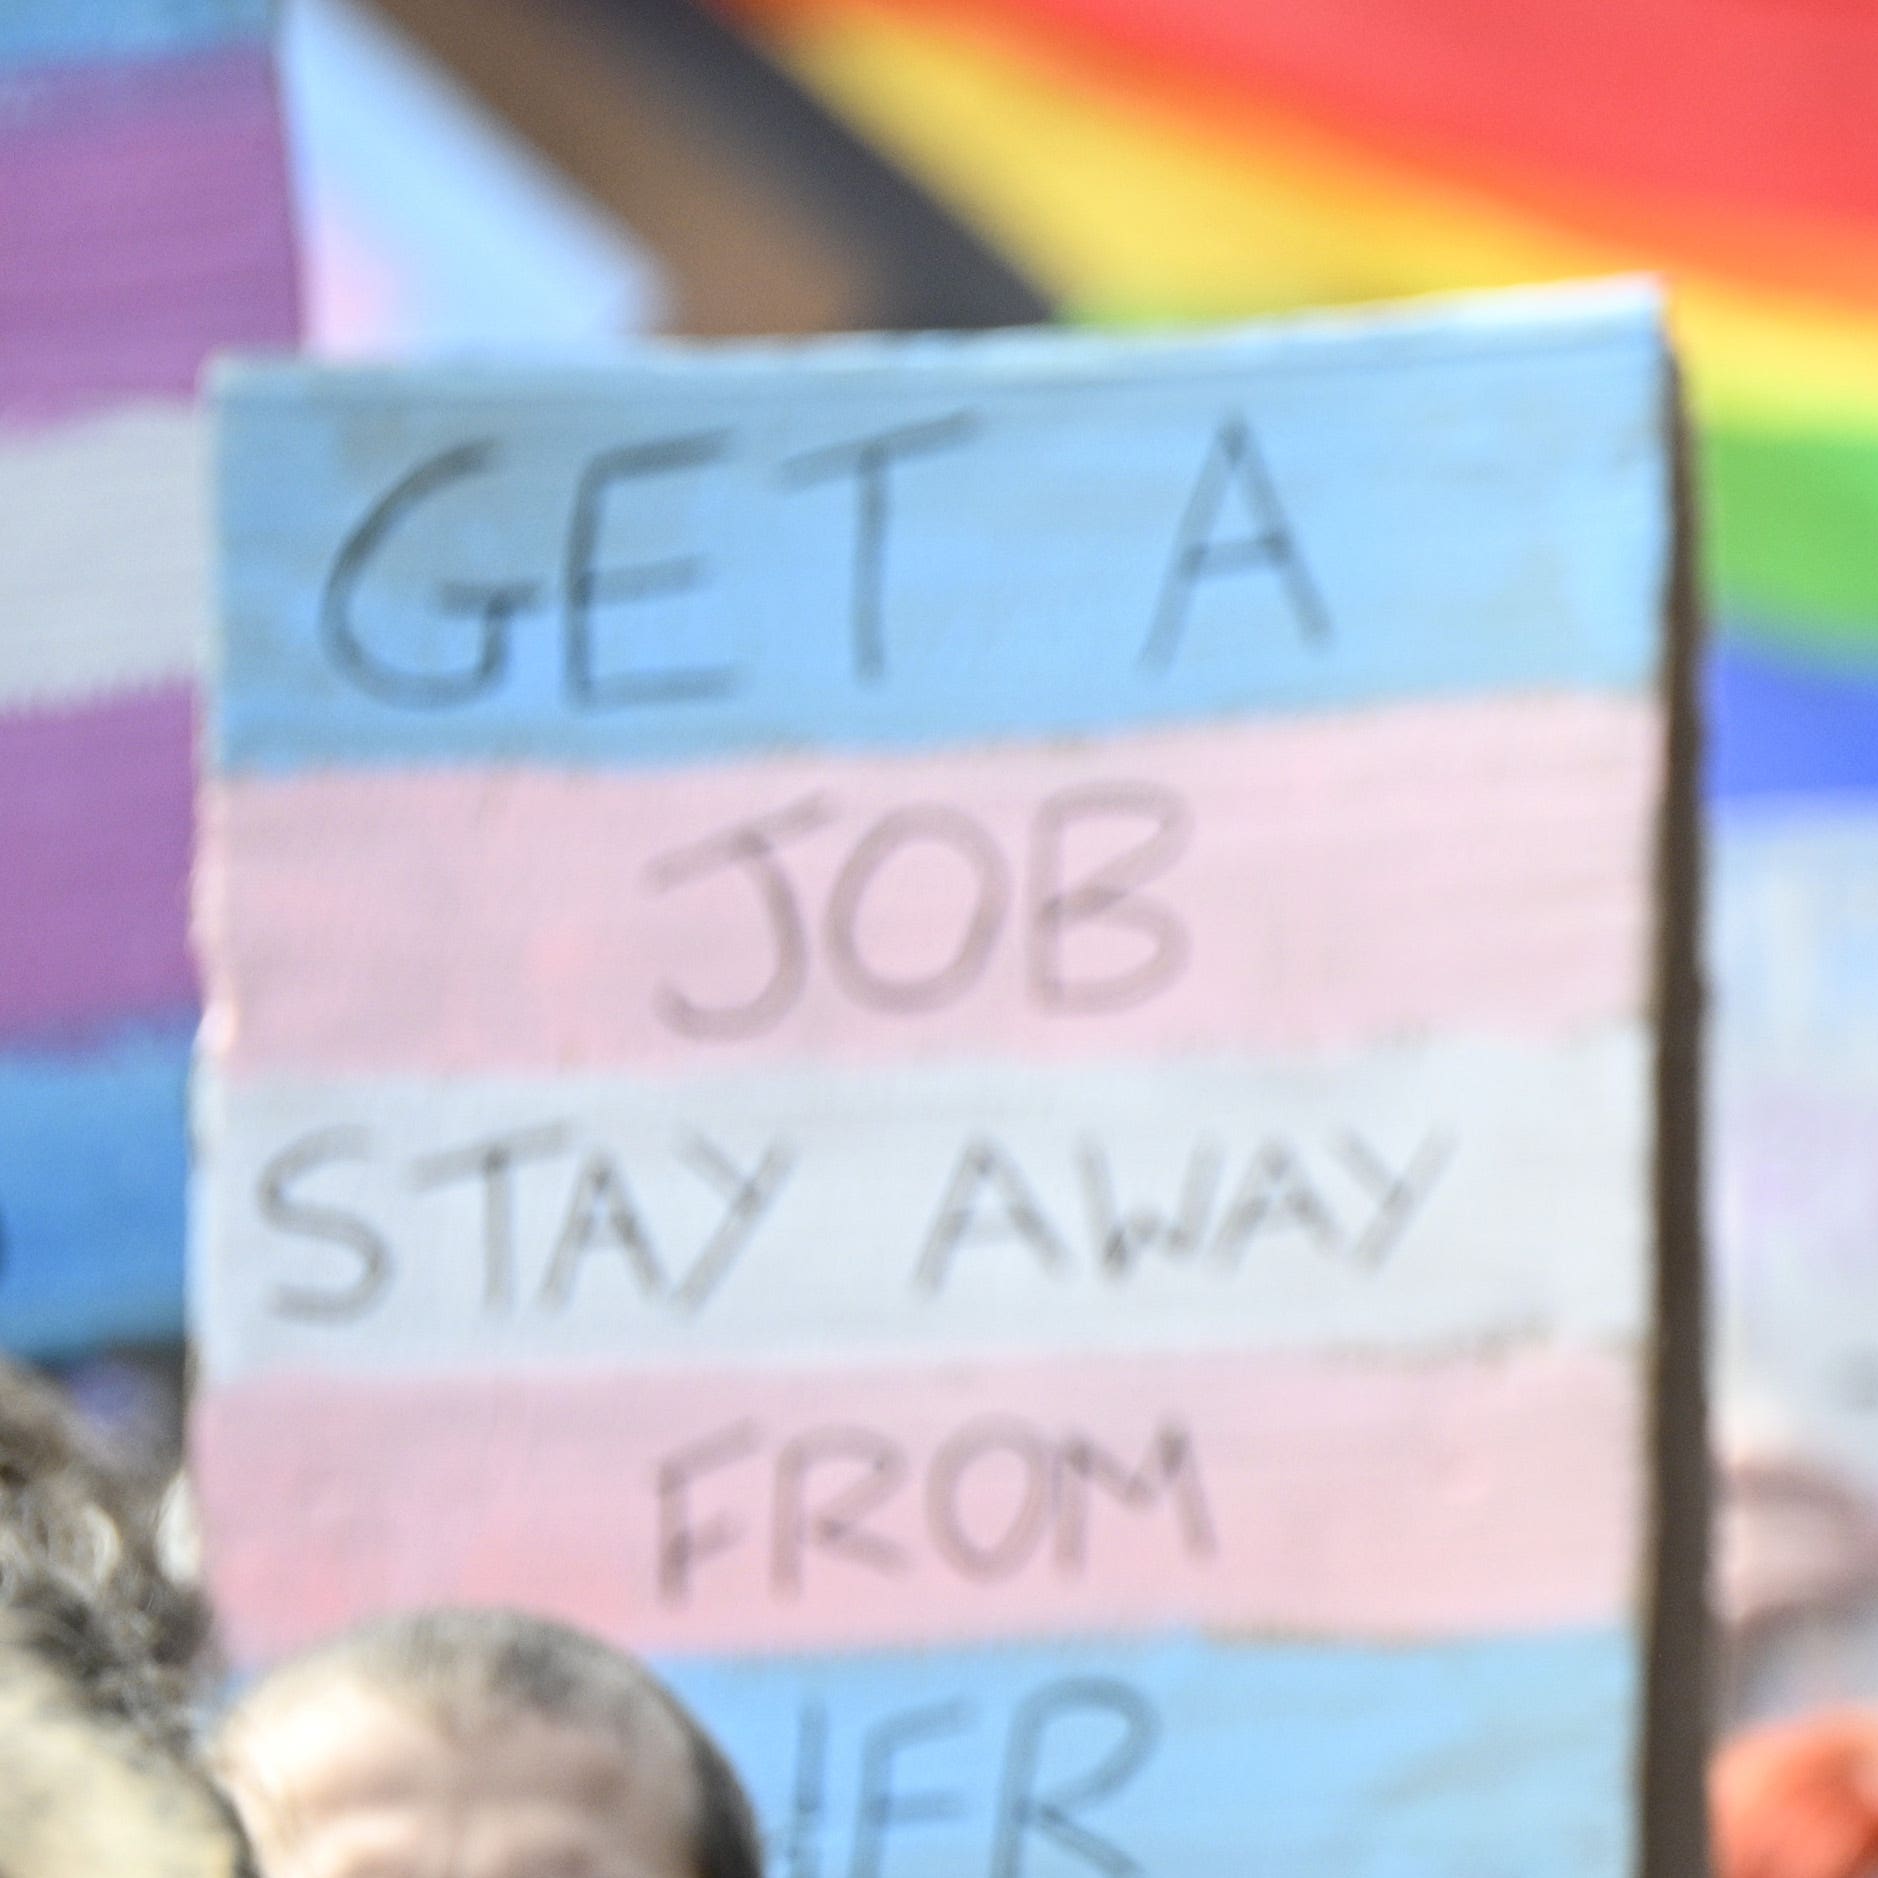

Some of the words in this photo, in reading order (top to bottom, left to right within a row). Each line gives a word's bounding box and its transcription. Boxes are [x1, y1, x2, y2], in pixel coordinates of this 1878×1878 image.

[326, 414, 980, 708] GET
[1144, 412, 1334, 680] A
[640, 780, 1194, 1046] JOB
[256, 1118, 796, 1324] STAY
[910, 1115, 1460, 1300] AWAY
[654, 1414, 1218, 1610] FROM
